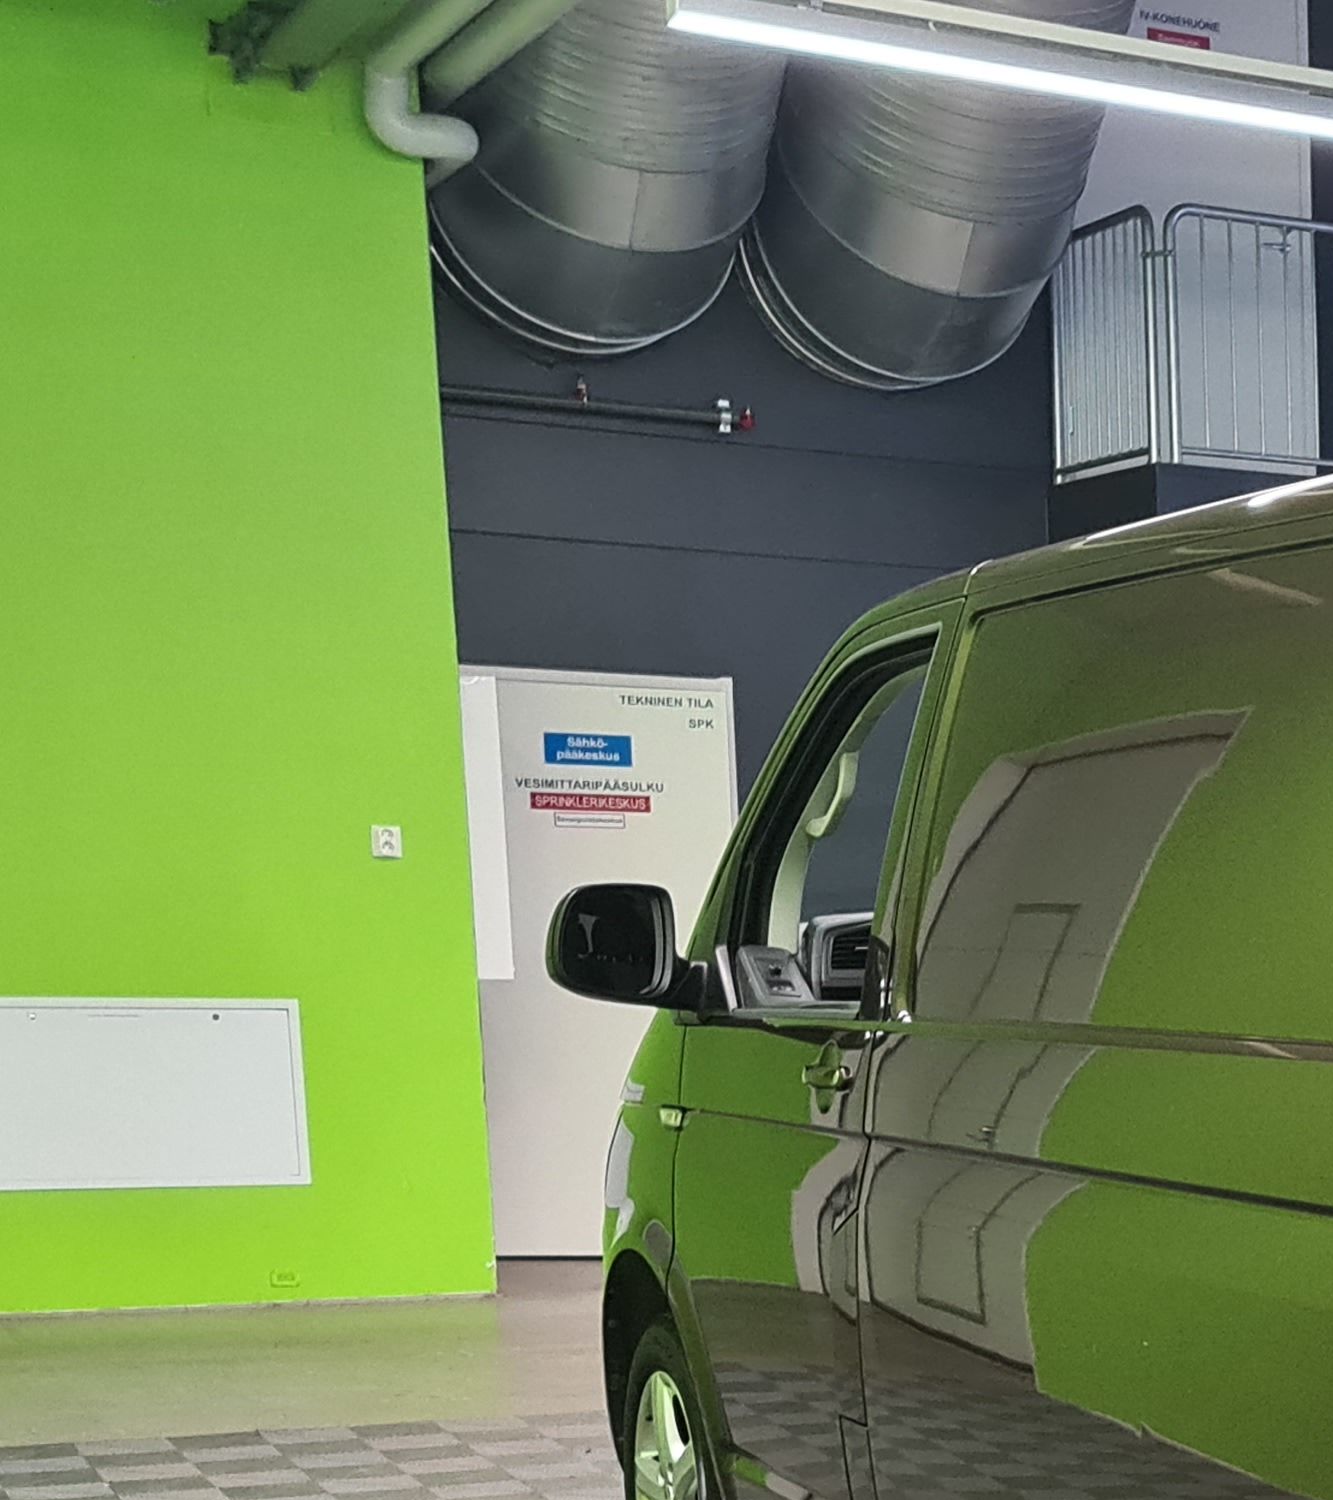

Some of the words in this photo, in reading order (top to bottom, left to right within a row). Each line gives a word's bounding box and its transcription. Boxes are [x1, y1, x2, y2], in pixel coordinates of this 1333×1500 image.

[619, 694, 682, 708] TEKNINEN
[687, 697, 714, 709] TILA
[688, 719, 714, 729] SPK
[566, 736, 608, 749] Sähkö-
[556, 749, 620, 762] pääkeskus
[515, 777, 664, 793] VESIMITTARIPÄÄSULKU
[534, 795, 647, 810] SPRINKLERIKESKUS
